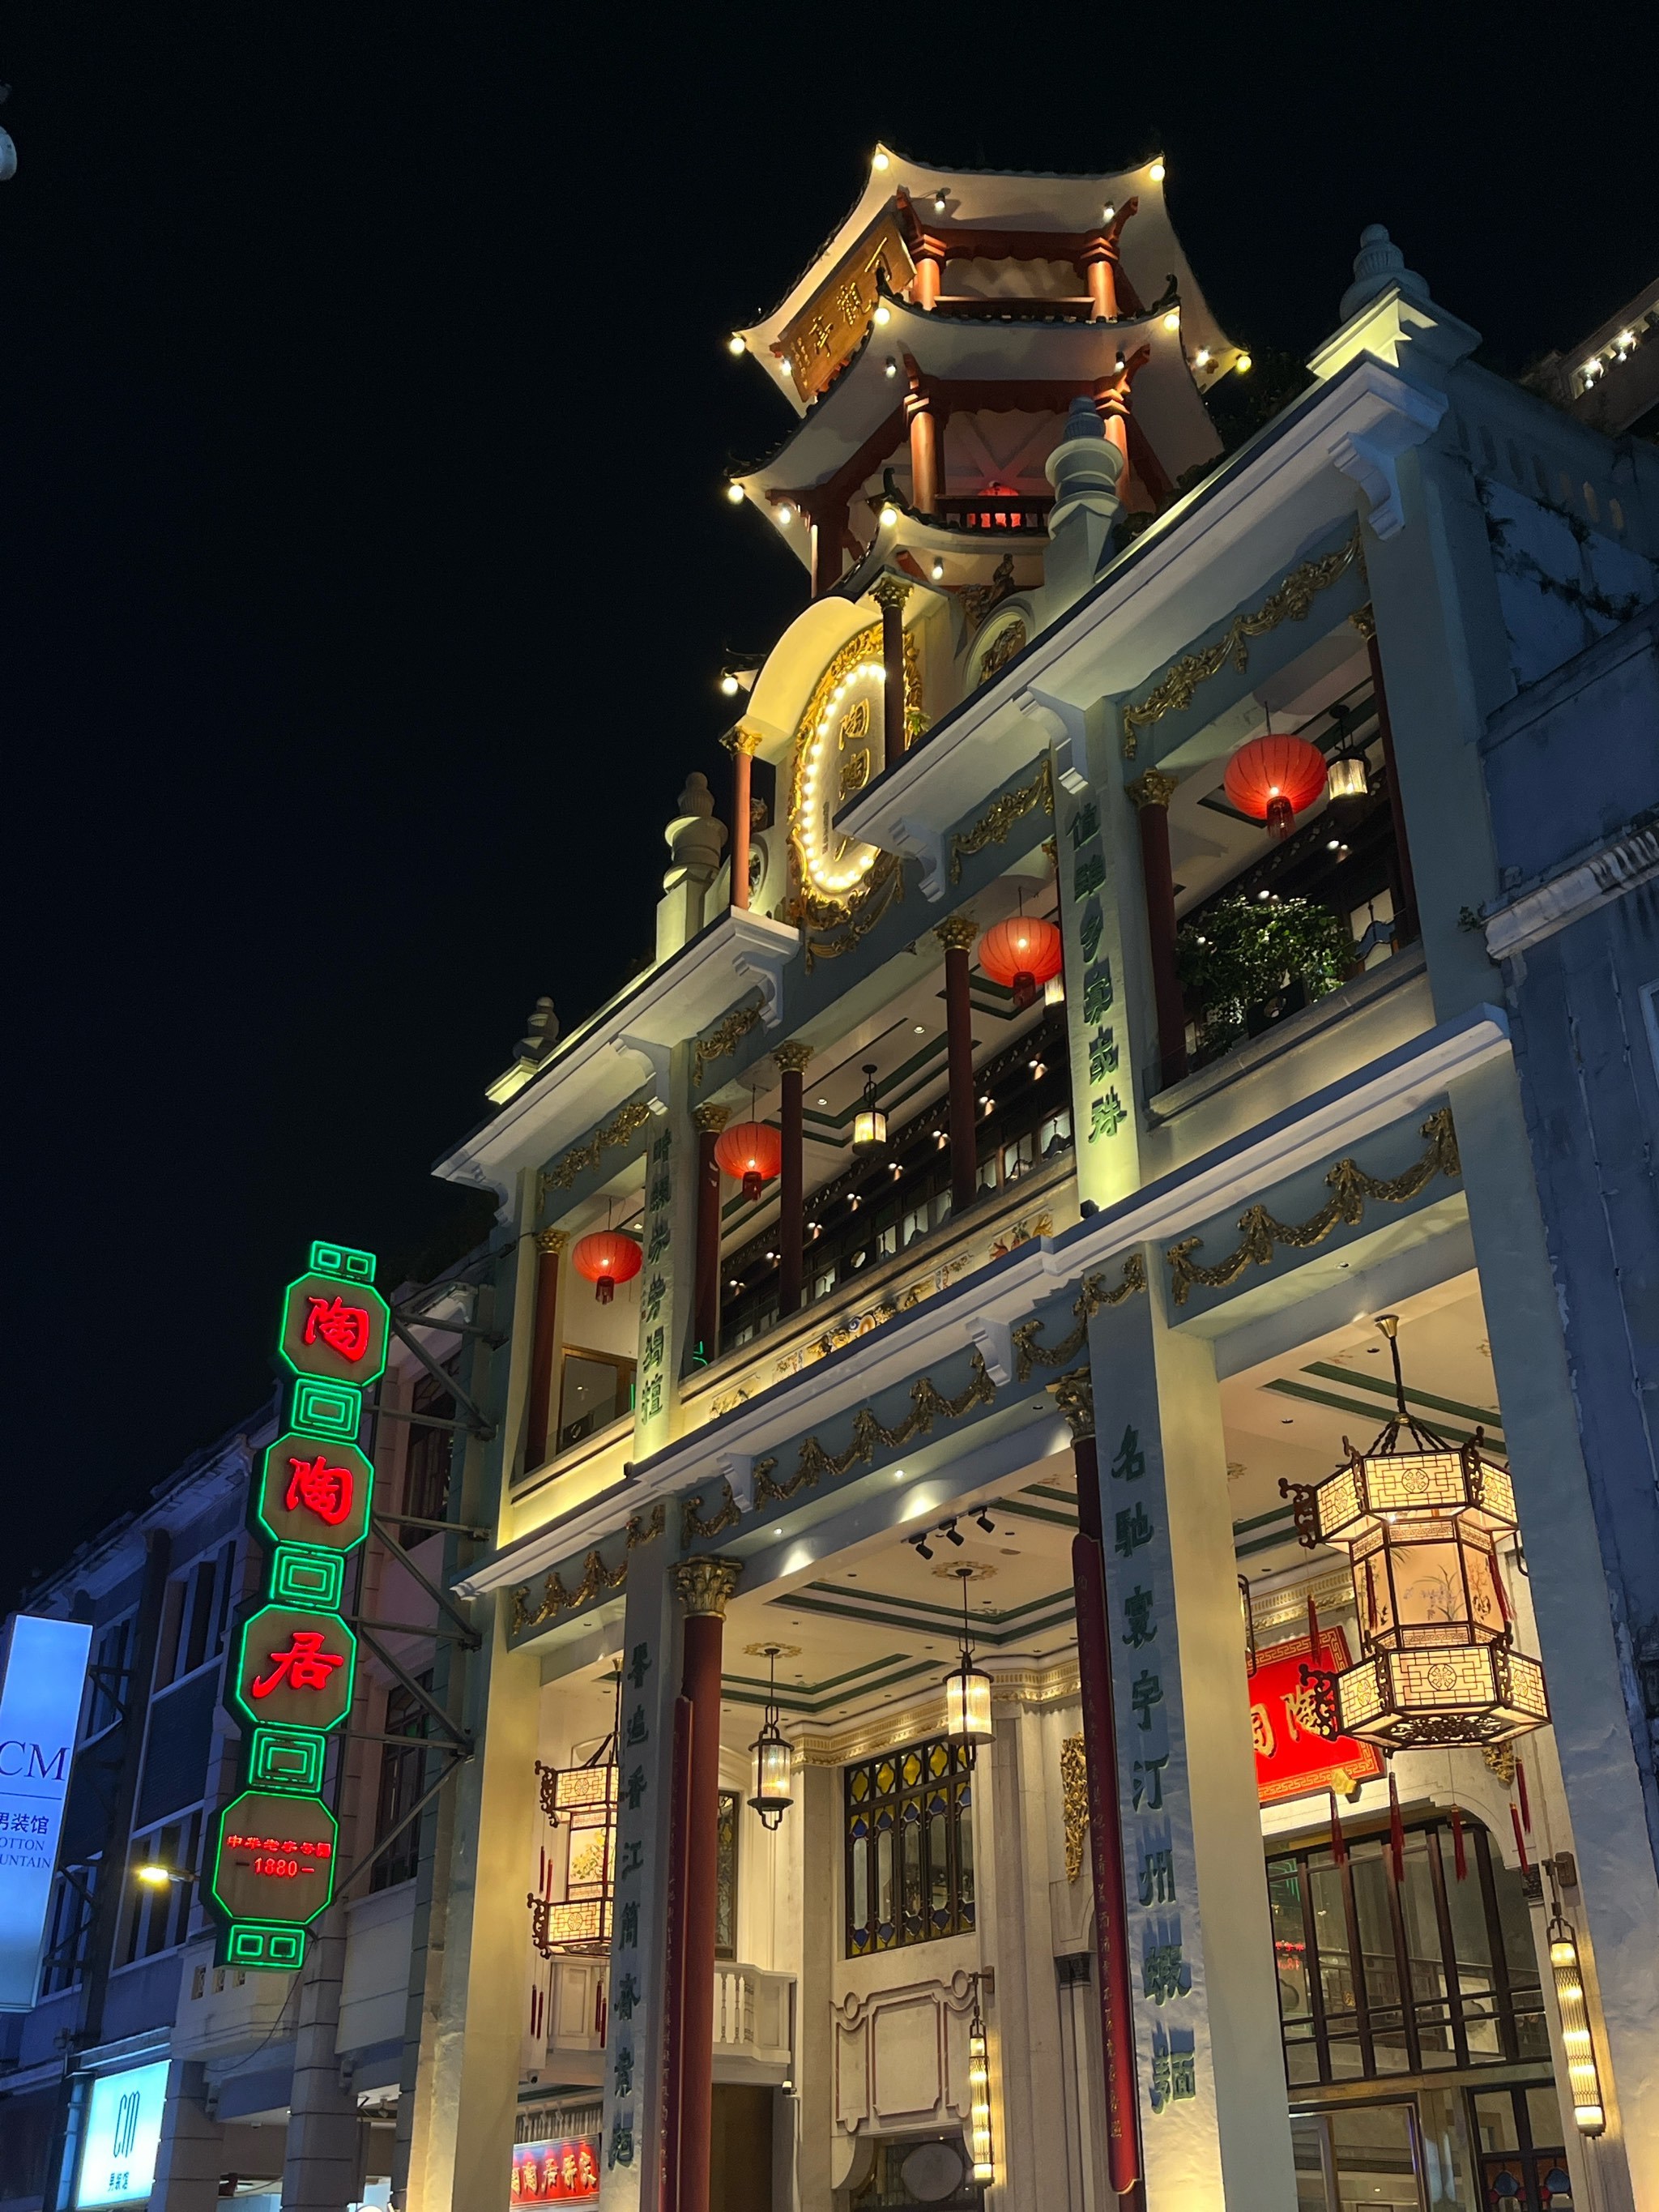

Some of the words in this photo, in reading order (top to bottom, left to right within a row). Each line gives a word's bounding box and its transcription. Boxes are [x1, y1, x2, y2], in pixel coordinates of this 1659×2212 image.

[252, 1295, 371, 1700] 陶陶居
[0, 1741, 70, 1780] CM
[254, 1856, 299, 1877] 1880
